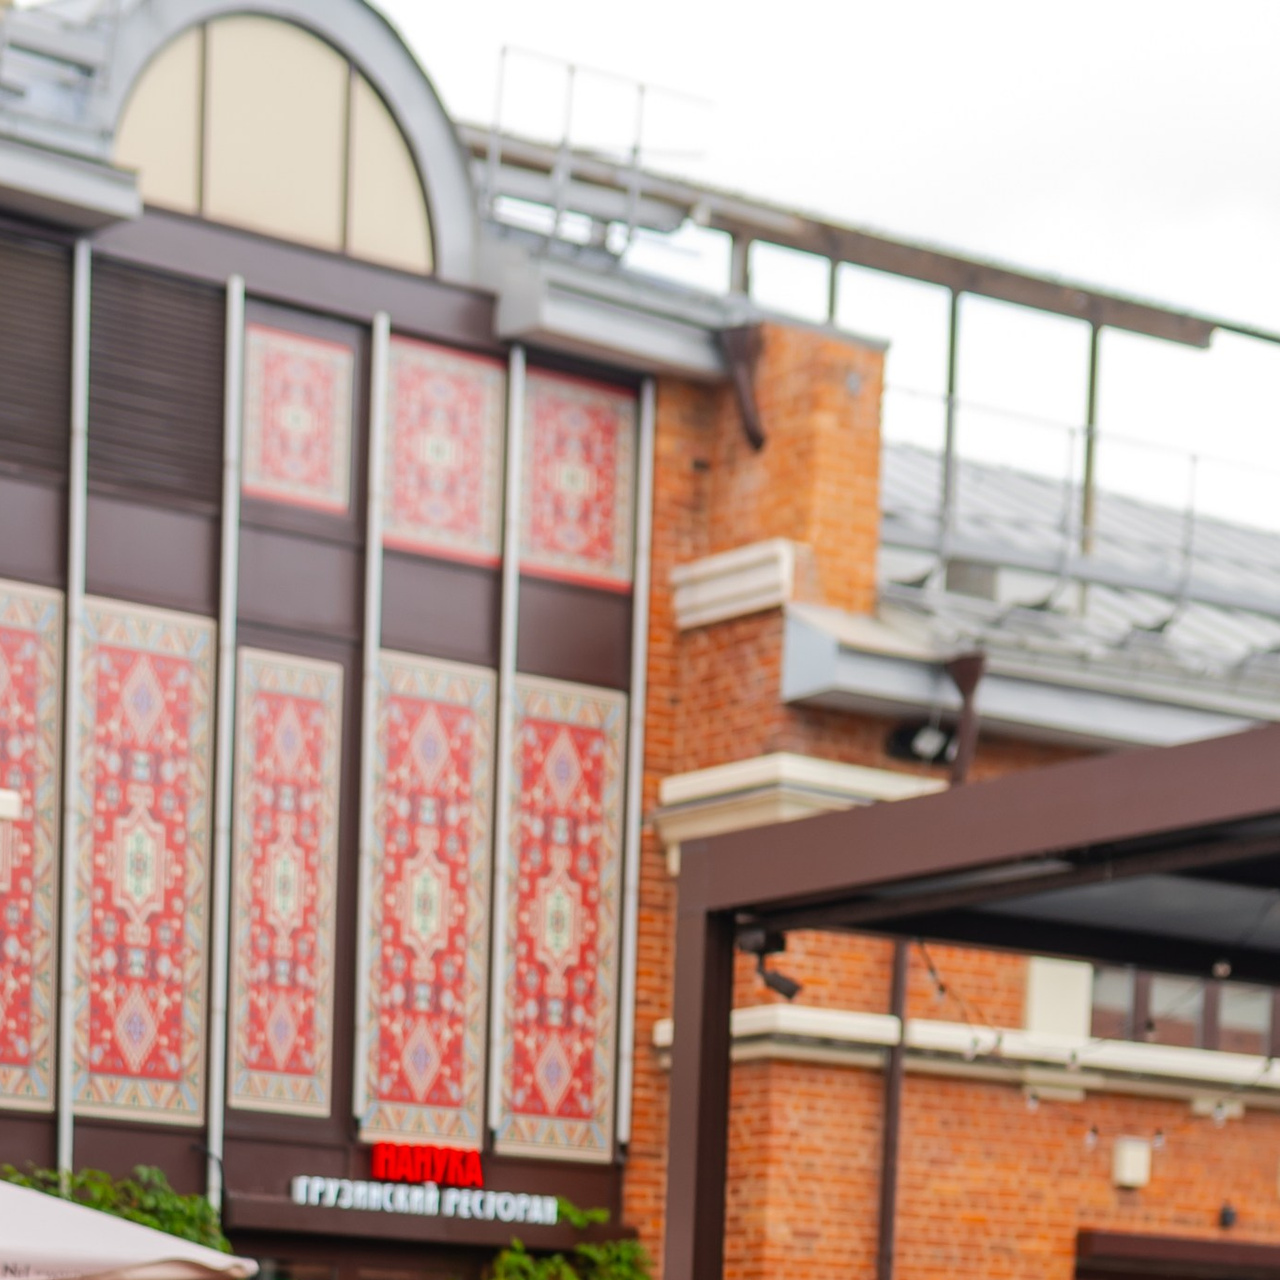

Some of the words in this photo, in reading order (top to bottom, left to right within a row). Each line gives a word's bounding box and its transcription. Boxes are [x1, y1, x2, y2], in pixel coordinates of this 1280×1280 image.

[372, 1142, 483, 1187] НАНУКА
[292, 1175, 439, 1216] ГРУЗИНСКИЙ
[441, 1187, 558, 1225] РЕСТОРАН
